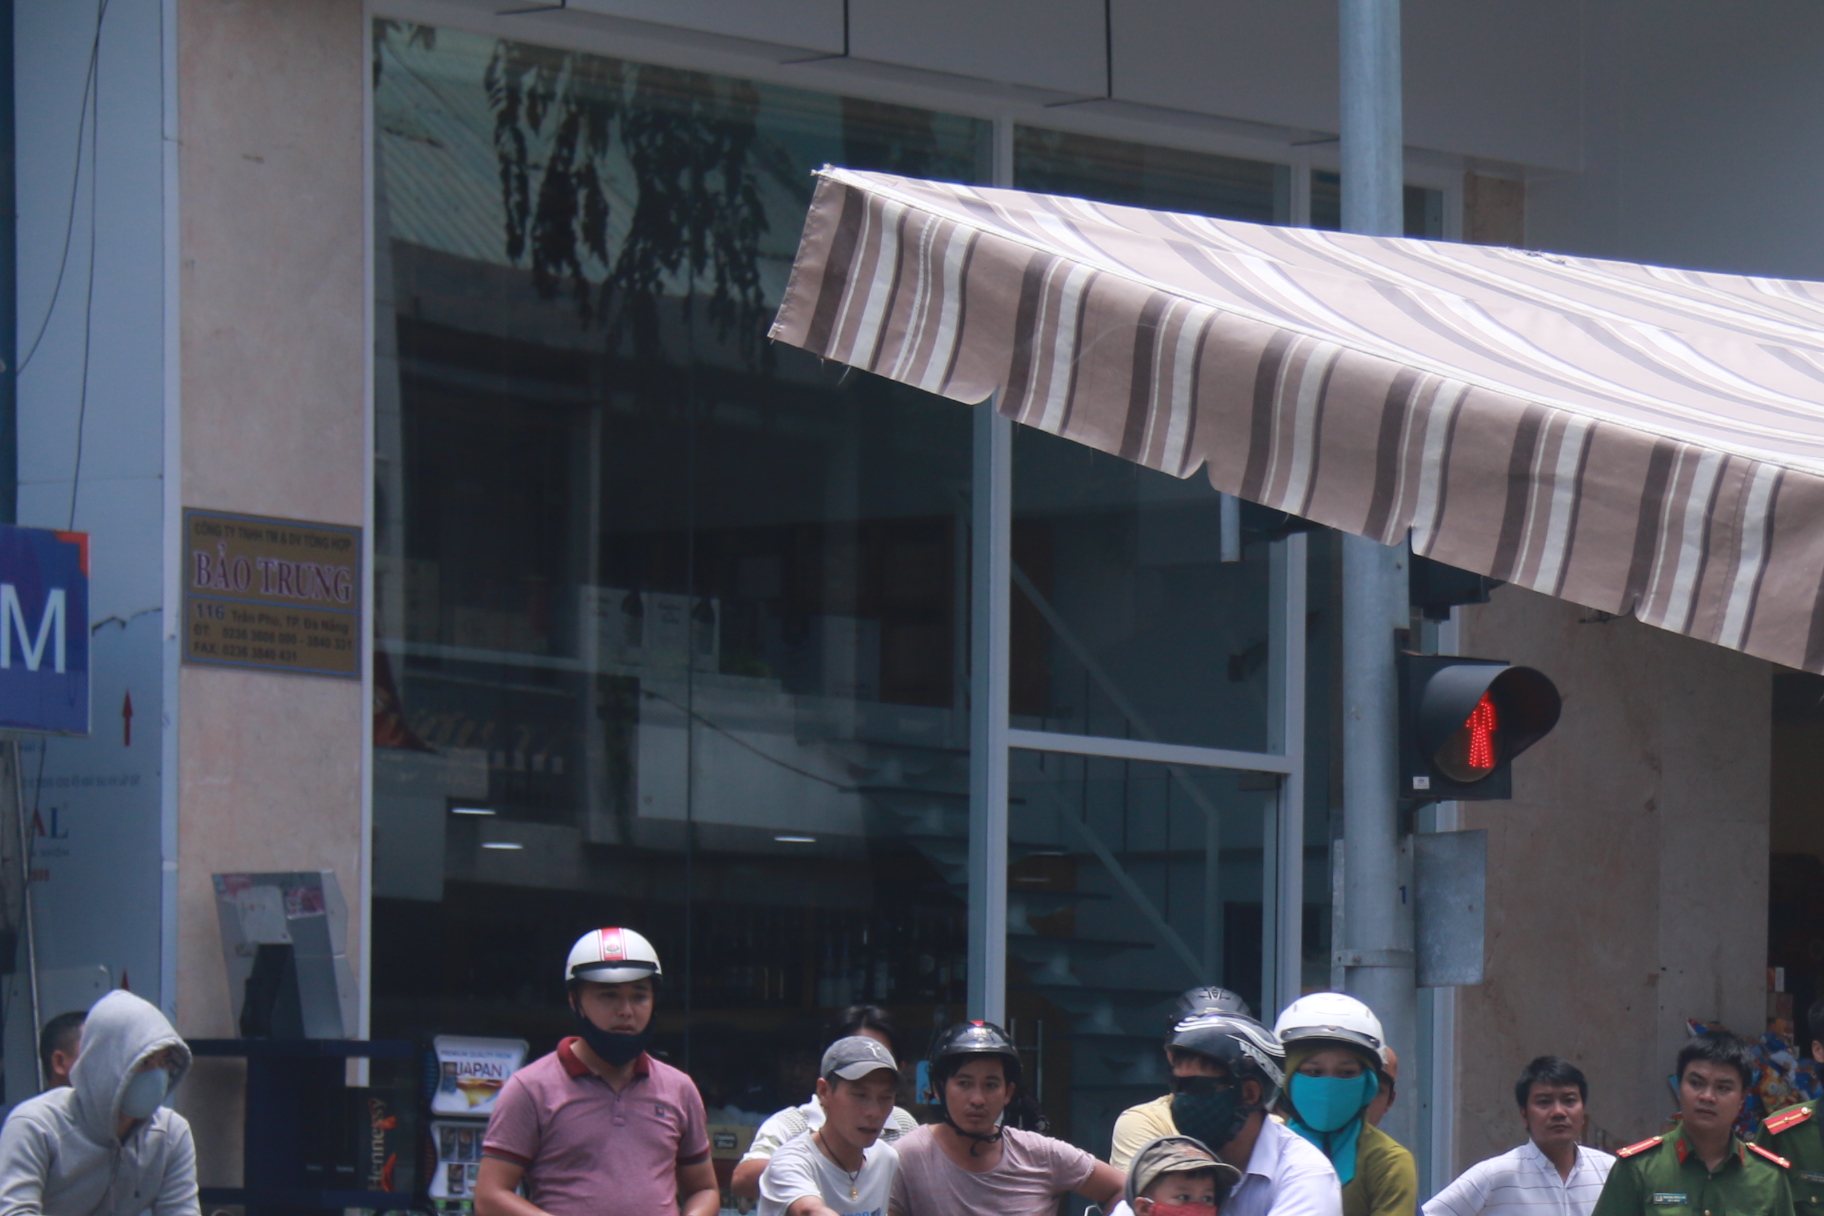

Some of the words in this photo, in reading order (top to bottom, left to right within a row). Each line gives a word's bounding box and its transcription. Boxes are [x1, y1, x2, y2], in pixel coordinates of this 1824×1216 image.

[193, 541, 251, 591] BẢO
[256, 557, 353, 603] TRUNG
[196, 603, 225, 621] 116
[456, 1061, 503, 1078] JAPAN
[368, 1097, 387, 1190] Hennessy
